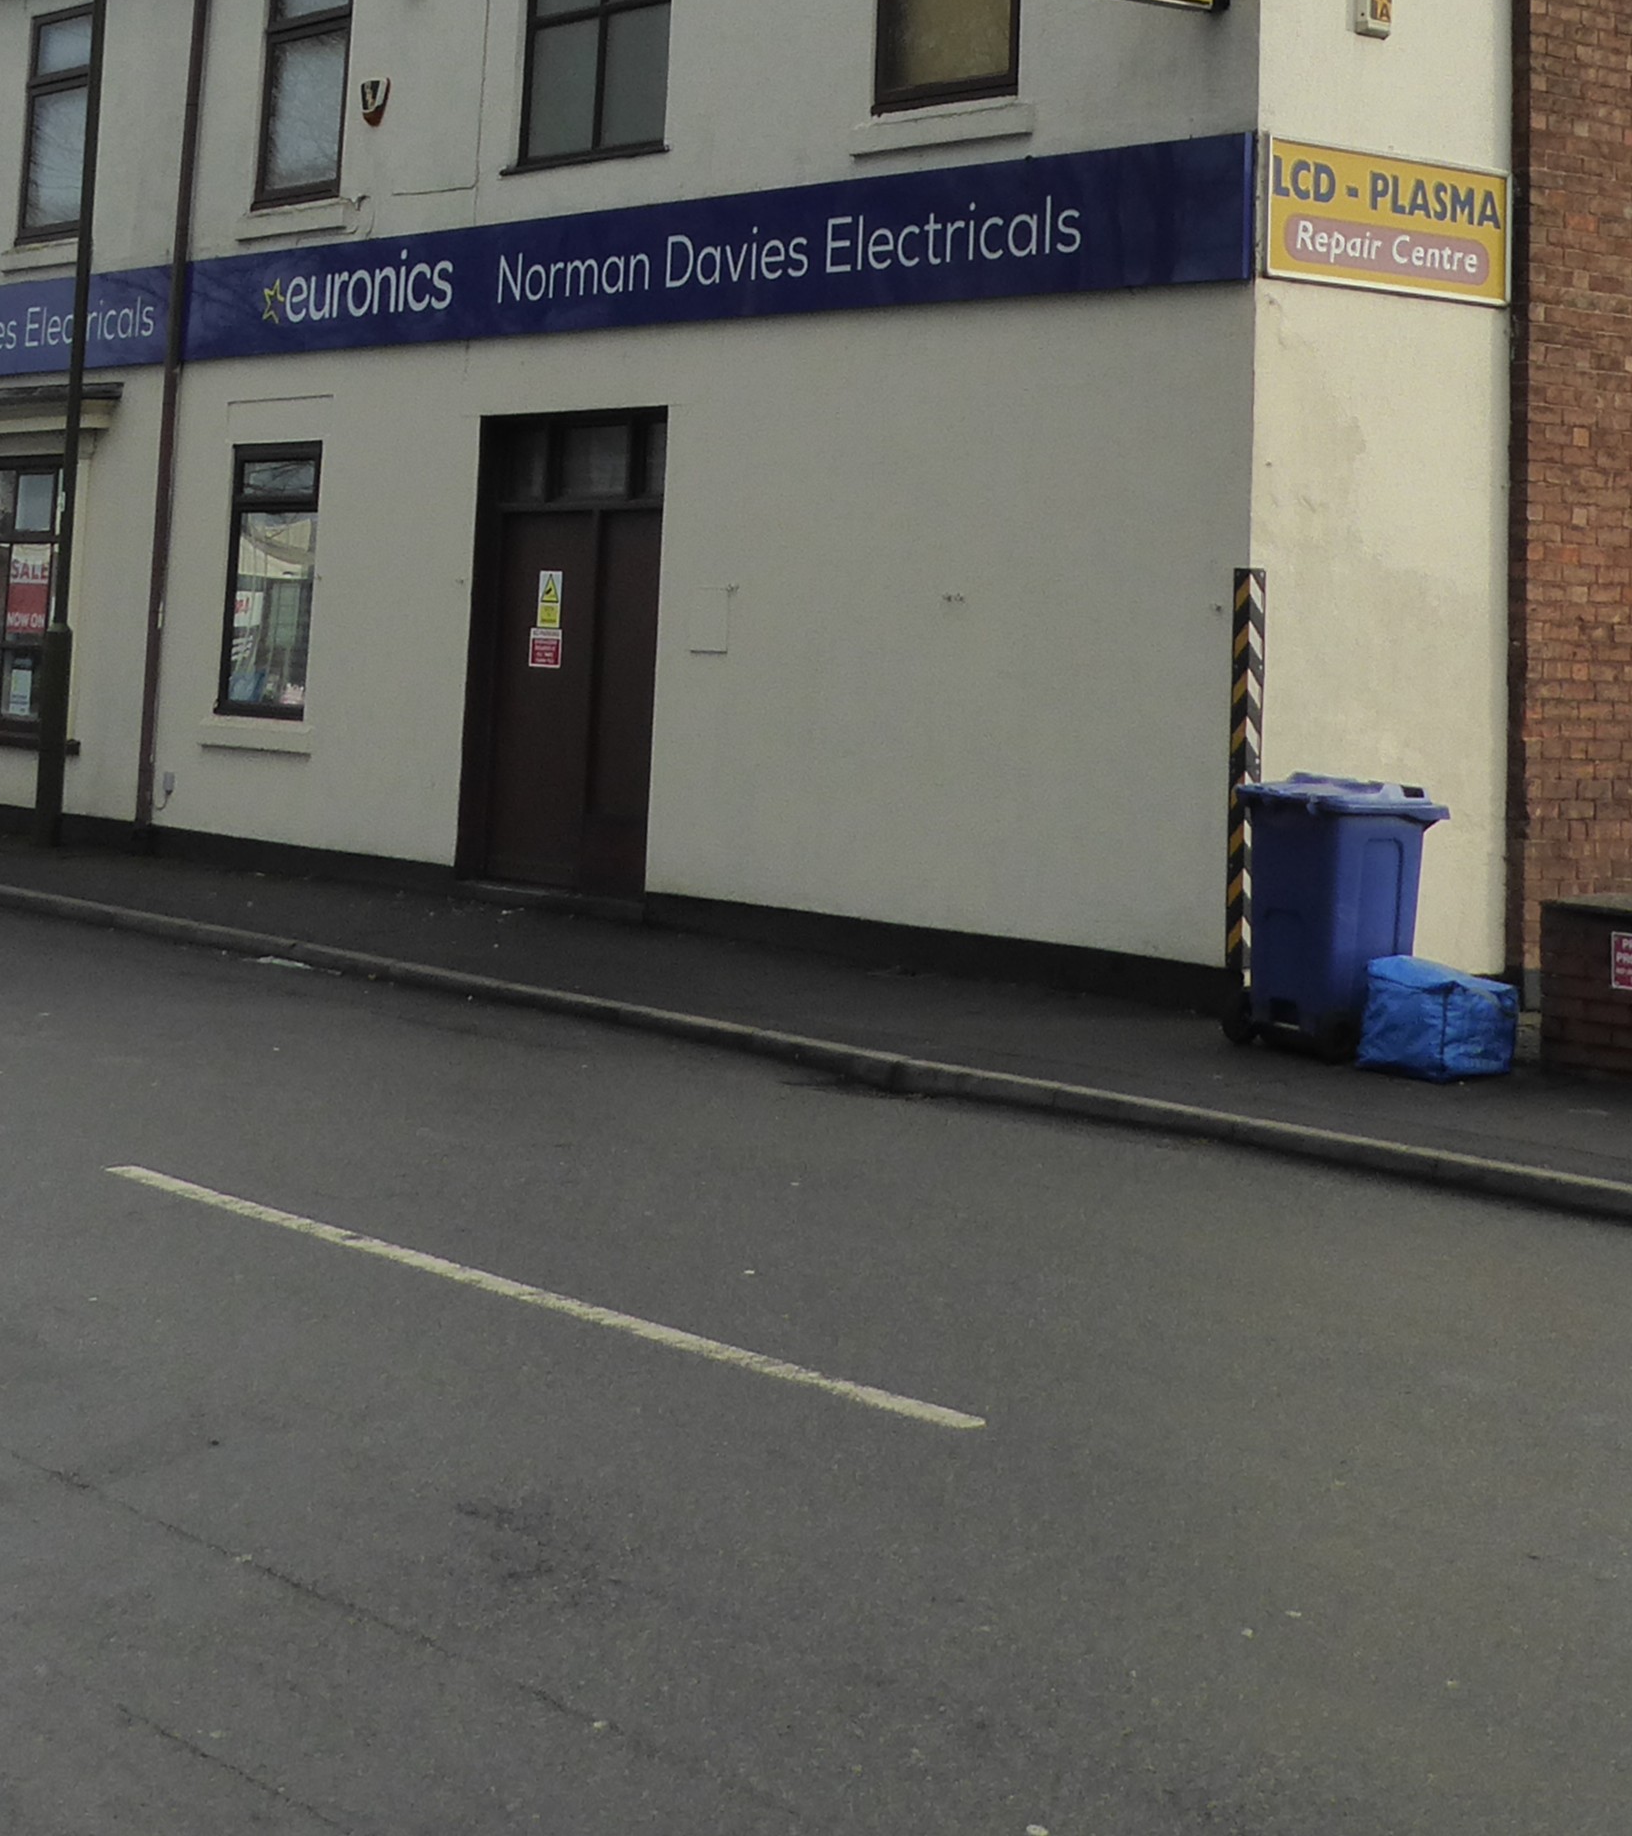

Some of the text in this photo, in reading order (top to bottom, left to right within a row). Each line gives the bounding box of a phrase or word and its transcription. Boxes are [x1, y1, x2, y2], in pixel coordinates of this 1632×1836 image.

[1273, 155, 1336, 203] LCD
[1369, 170, 1501, 229] PLASMA
[285, 195, 1082, 323] euronics Norman Davies Electricals
[1296, 220, 1478, 273] Repair Centre
[25, 296, 155, 348] Elecricals
[10, 559, 49, 581] SALE
[6, 612, 45, 629] NOW ON
